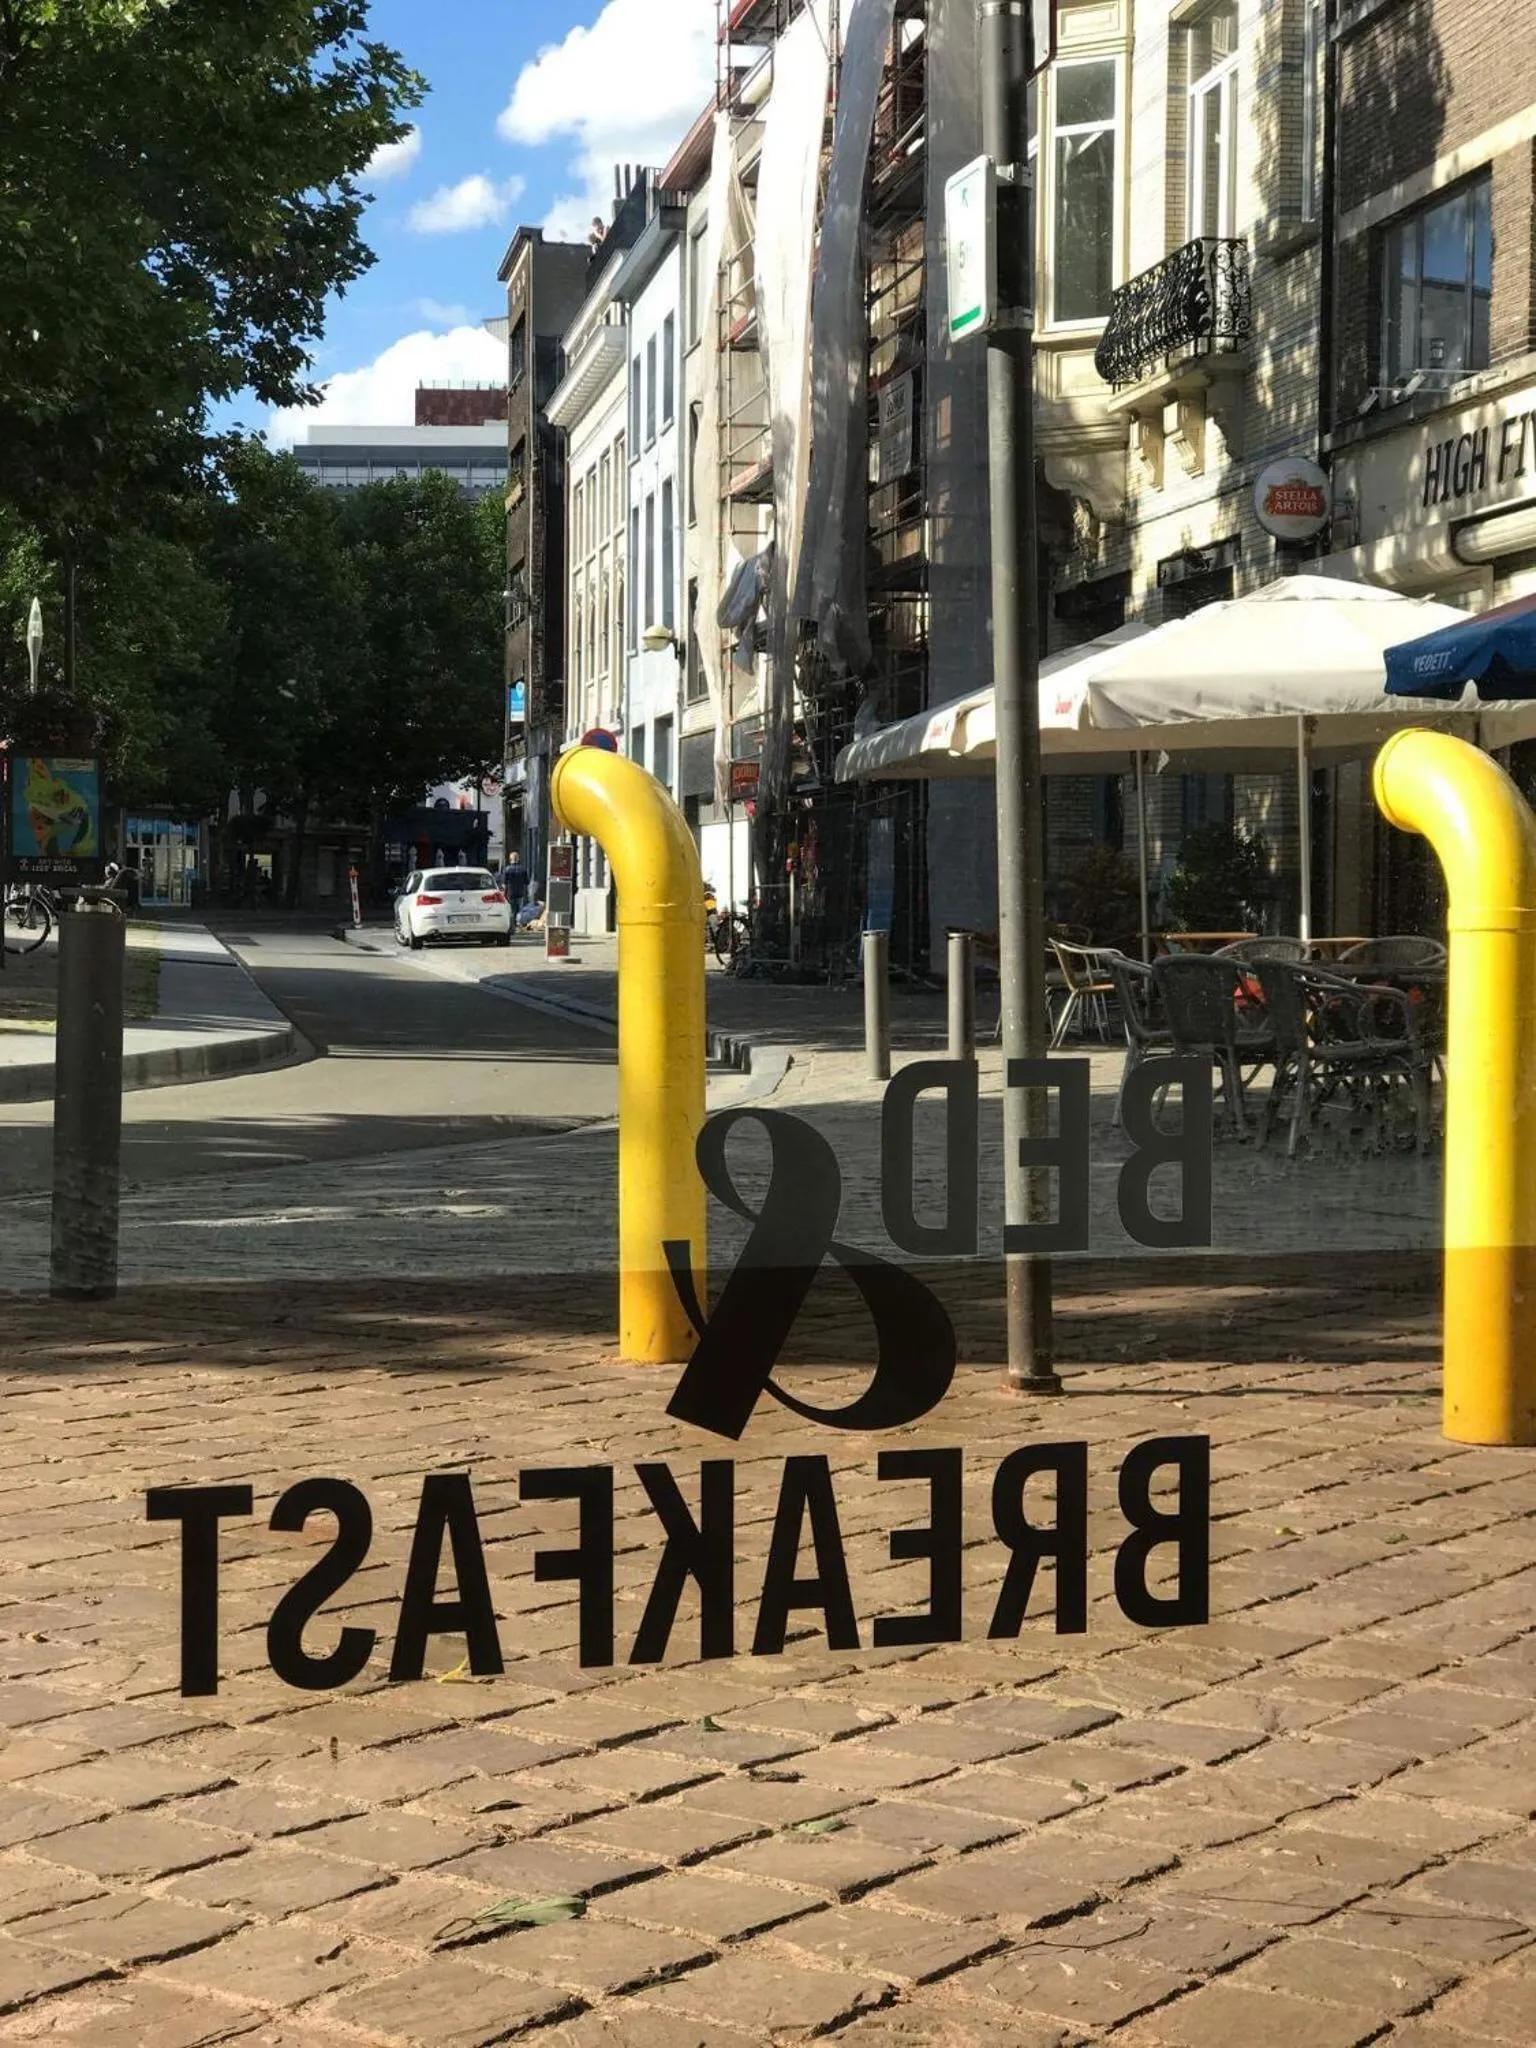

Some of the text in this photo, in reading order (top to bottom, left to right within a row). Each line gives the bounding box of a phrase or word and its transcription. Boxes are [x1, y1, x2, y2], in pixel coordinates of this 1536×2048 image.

[1423, 426, 1488, 507] HIGH
[1274, 490, 1317, 500] STELLA
[1274, 501, 1318, 512] ARTOIS
